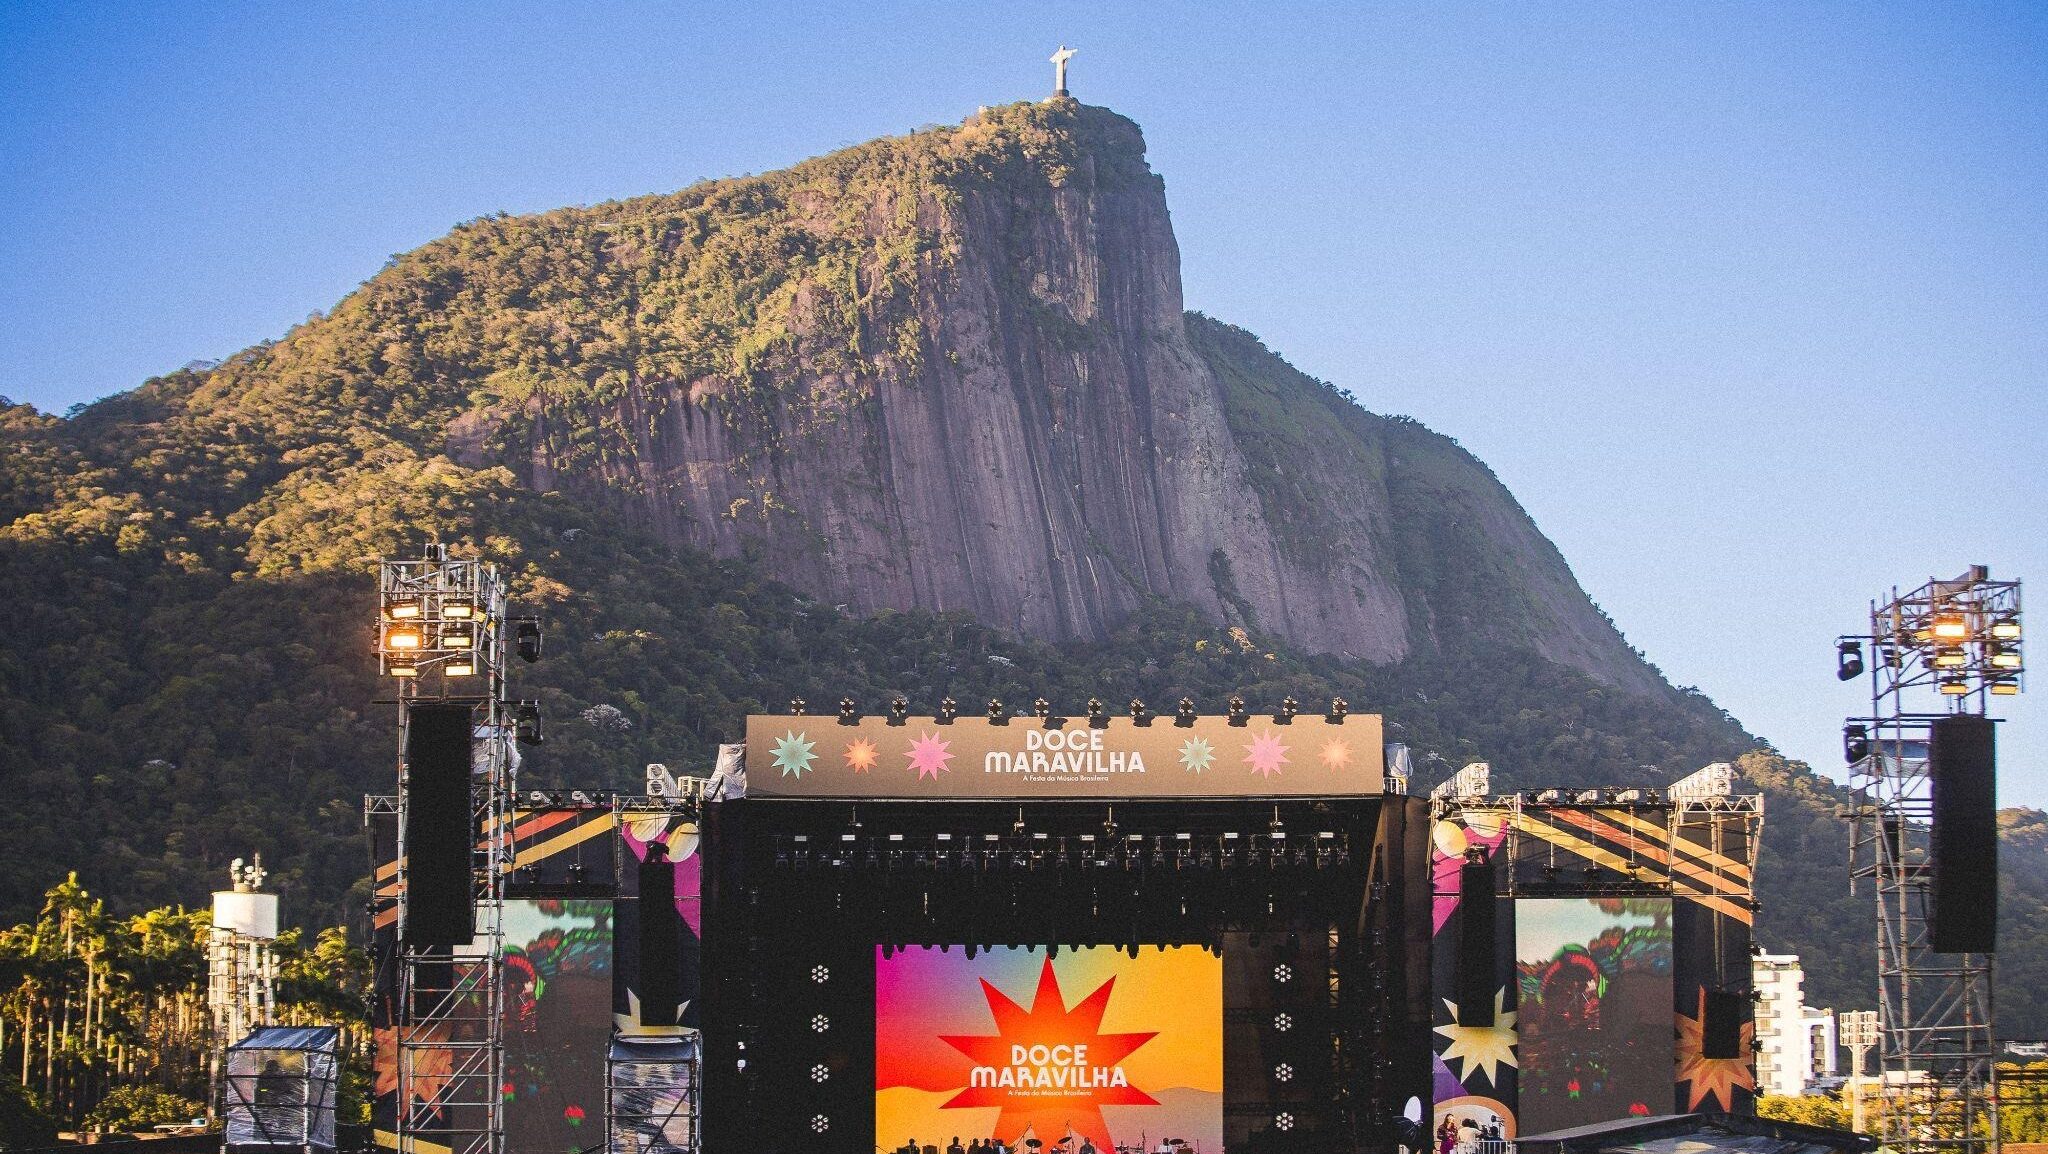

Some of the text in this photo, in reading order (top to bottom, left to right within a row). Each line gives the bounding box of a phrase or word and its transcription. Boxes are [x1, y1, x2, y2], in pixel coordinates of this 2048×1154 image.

[1026, 729, 1105, 751] DOCE
[984, 751, 1146, 773] MARAVILHA
[1029, 774, 1046, 782] Festa
[1046, 774, 1056, 782] da
[1057, 774, 1079, 782] Música
[1080, 774, 1109, 782] Brasileira
[1011, 1044, 1088, 1066] DOCE
[970, 1066, 1128, 1088] MARAVILHA
